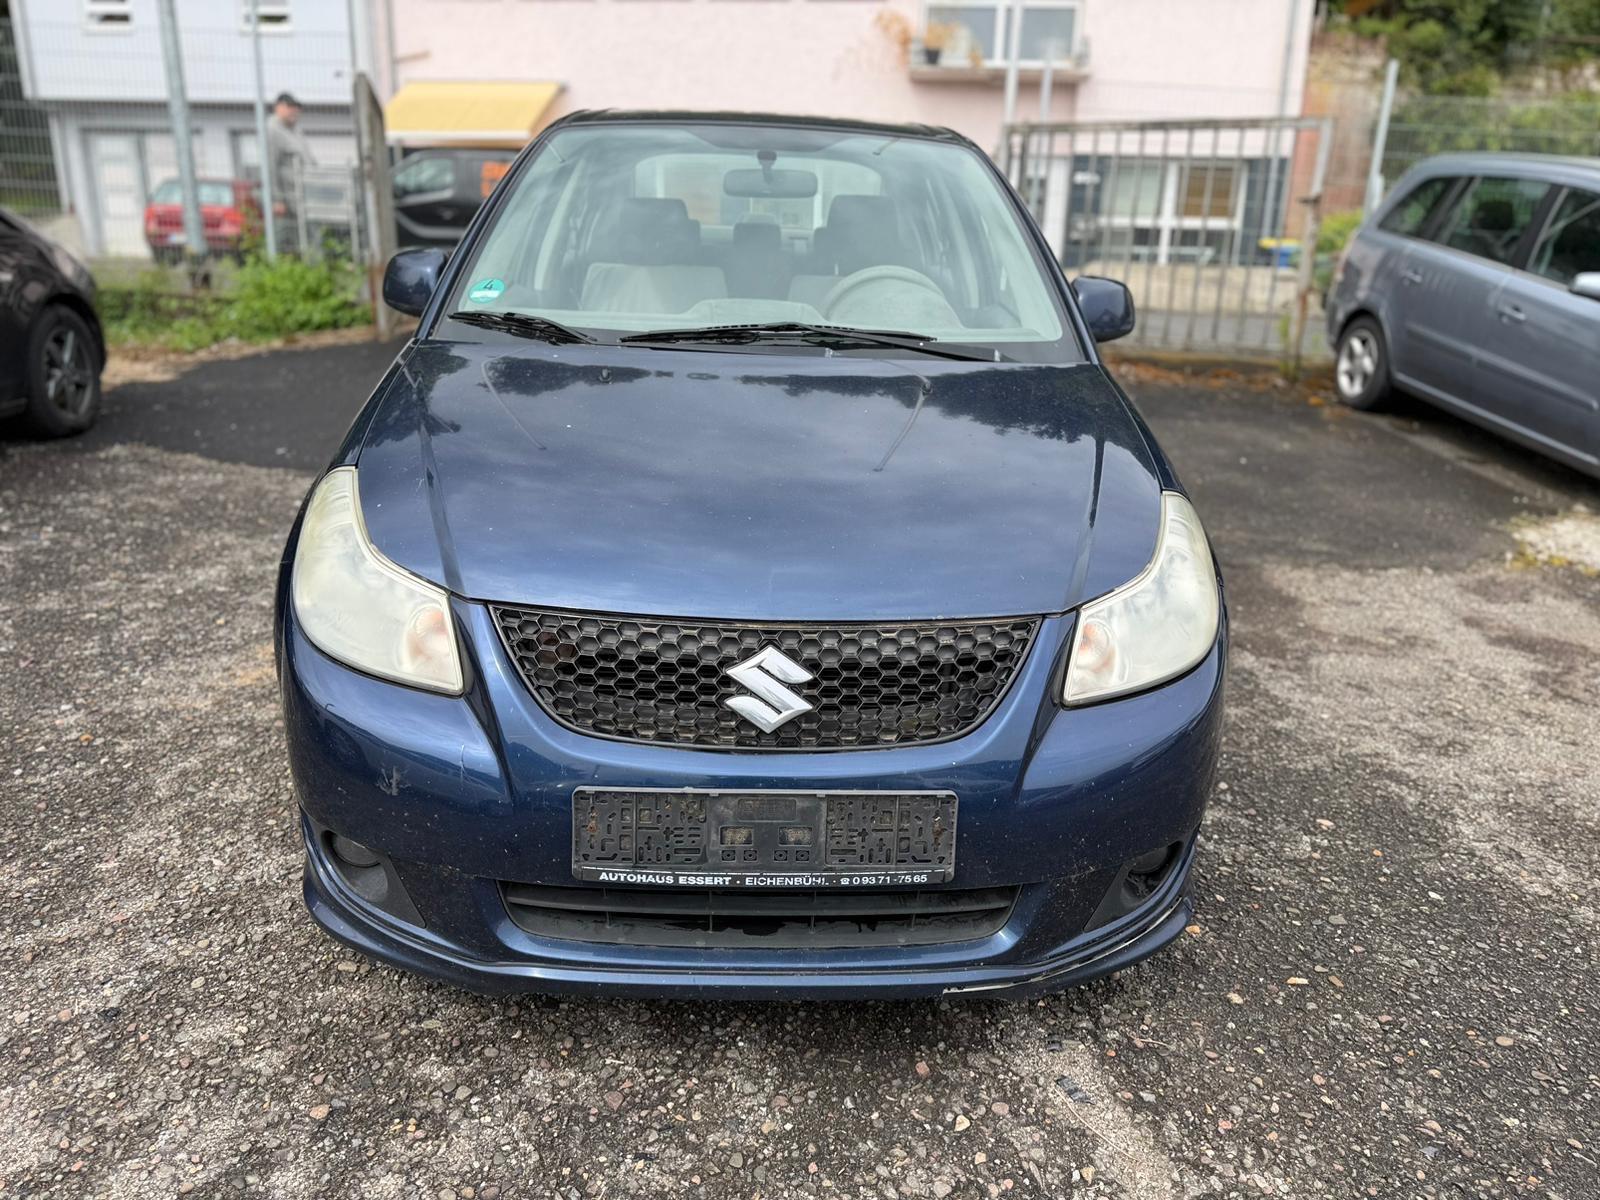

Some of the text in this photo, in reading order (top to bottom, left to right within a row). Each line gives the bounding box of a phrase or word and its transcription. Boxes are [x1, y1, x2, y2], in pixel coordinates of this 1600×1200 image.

[483, 279, 494, 290] 4
[599, 871, 674, 884] AUTOHAUS
[678, 875, 731, 885] ESSERT
